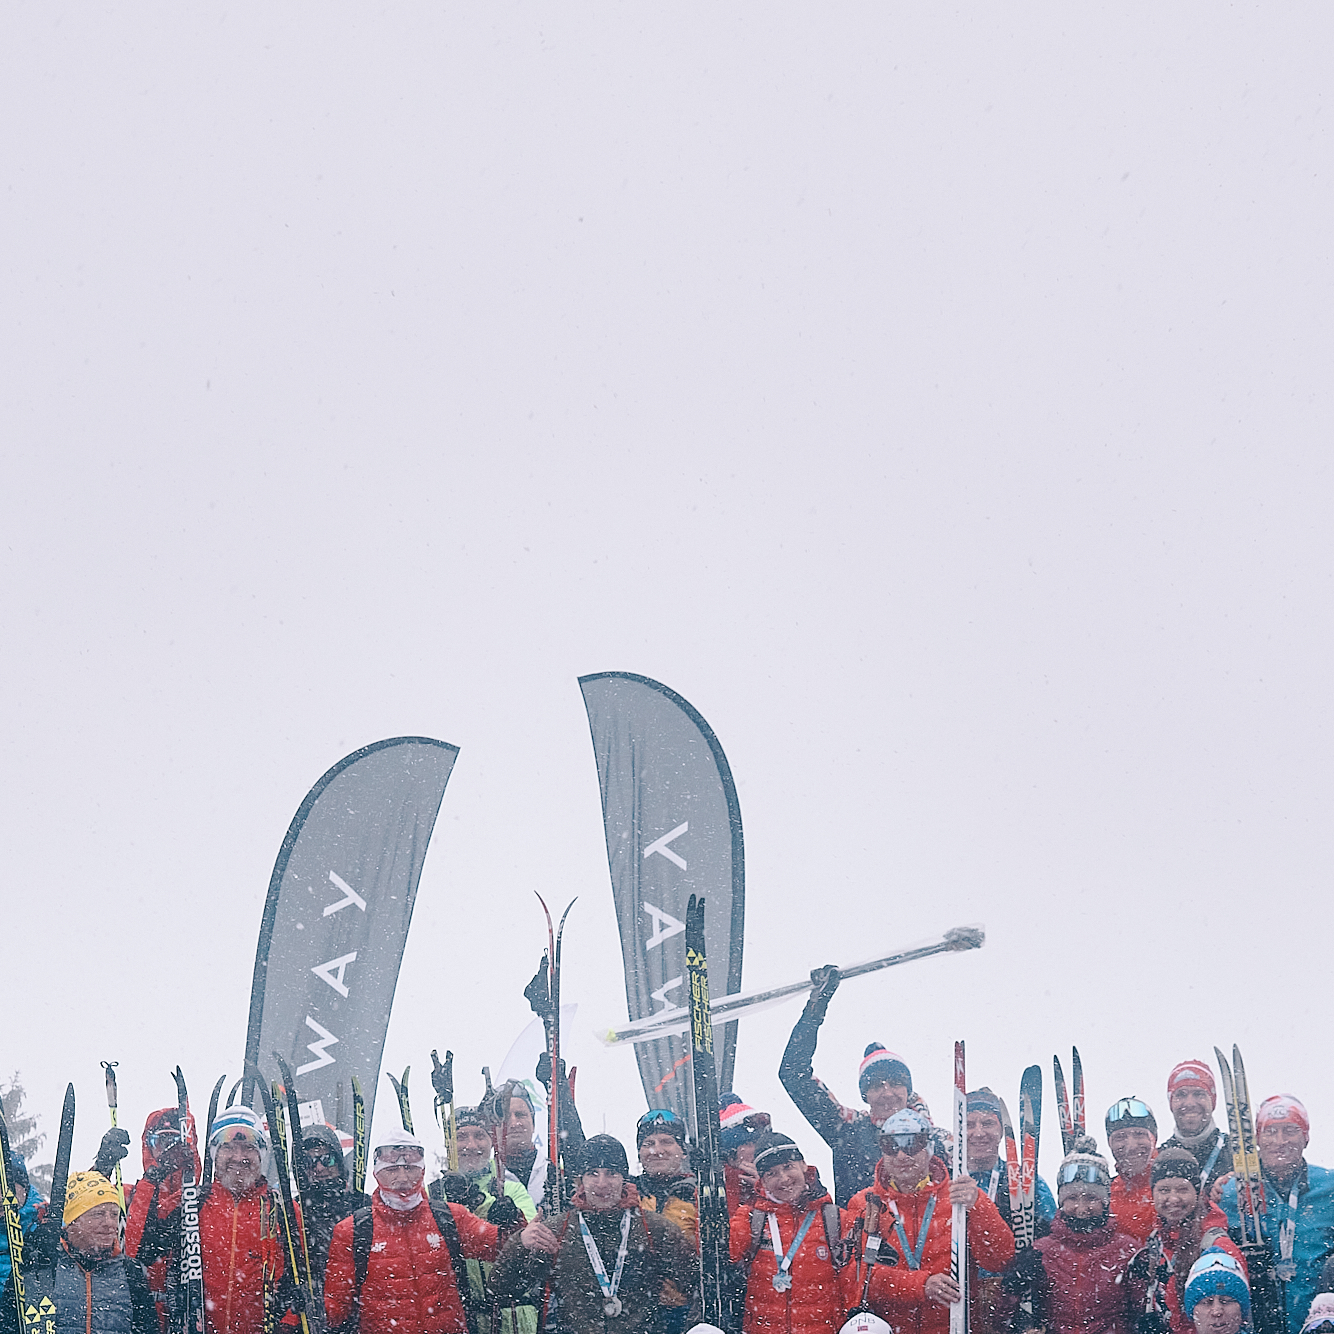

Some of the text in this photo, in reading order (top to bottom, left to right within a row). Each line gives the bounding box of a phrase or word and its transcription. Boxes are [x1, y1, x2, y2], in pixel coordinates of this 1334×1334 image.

[296, 870, 367, 1076] WAY
[692, 971, 703, 1053] FISCHER
[701, 975, 713, 1055] FISCHER
[355, 1103, 365, 1194] FISCHER
[185, 1175, 203, 1281] ROSSIGNOL
[850, 1315, 876, 1327] DNB
